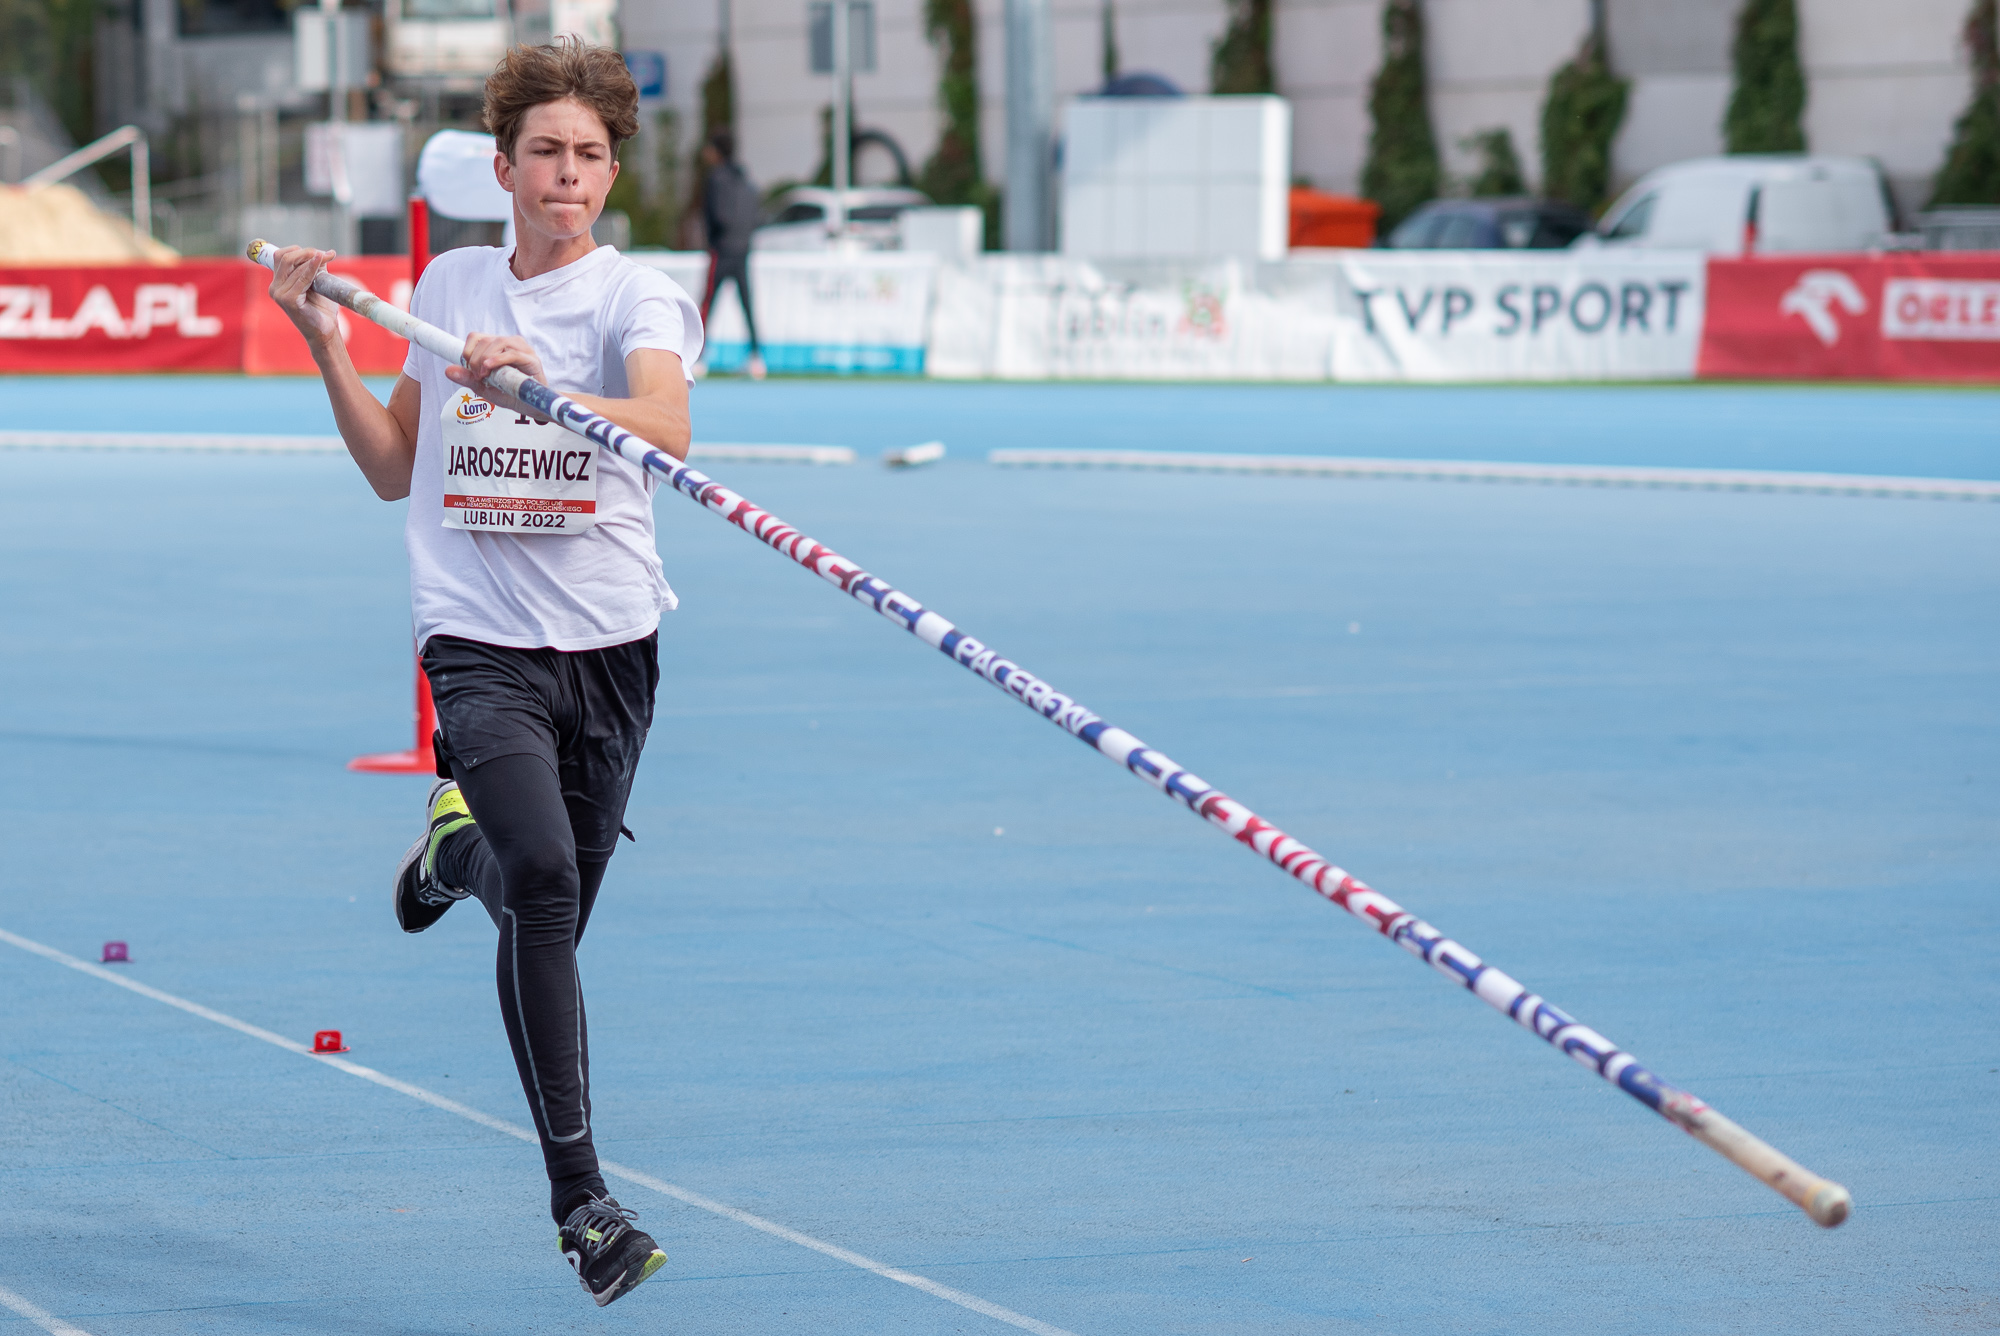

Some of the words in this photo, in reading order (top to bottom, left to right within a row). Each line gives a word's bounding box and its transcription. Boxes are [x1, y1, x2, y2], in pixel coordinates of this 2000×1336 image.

[1353, 285, 1475, 334] TVP
[1495, 282, 1691, 336] SPORT
[464, 402, 488, 415] LOTTO
[448, 445, 592, 481] JAROSZEWICZ
[464, 510, 515, 526] LUBLIN
[521, 513, 566, 528] 2022
